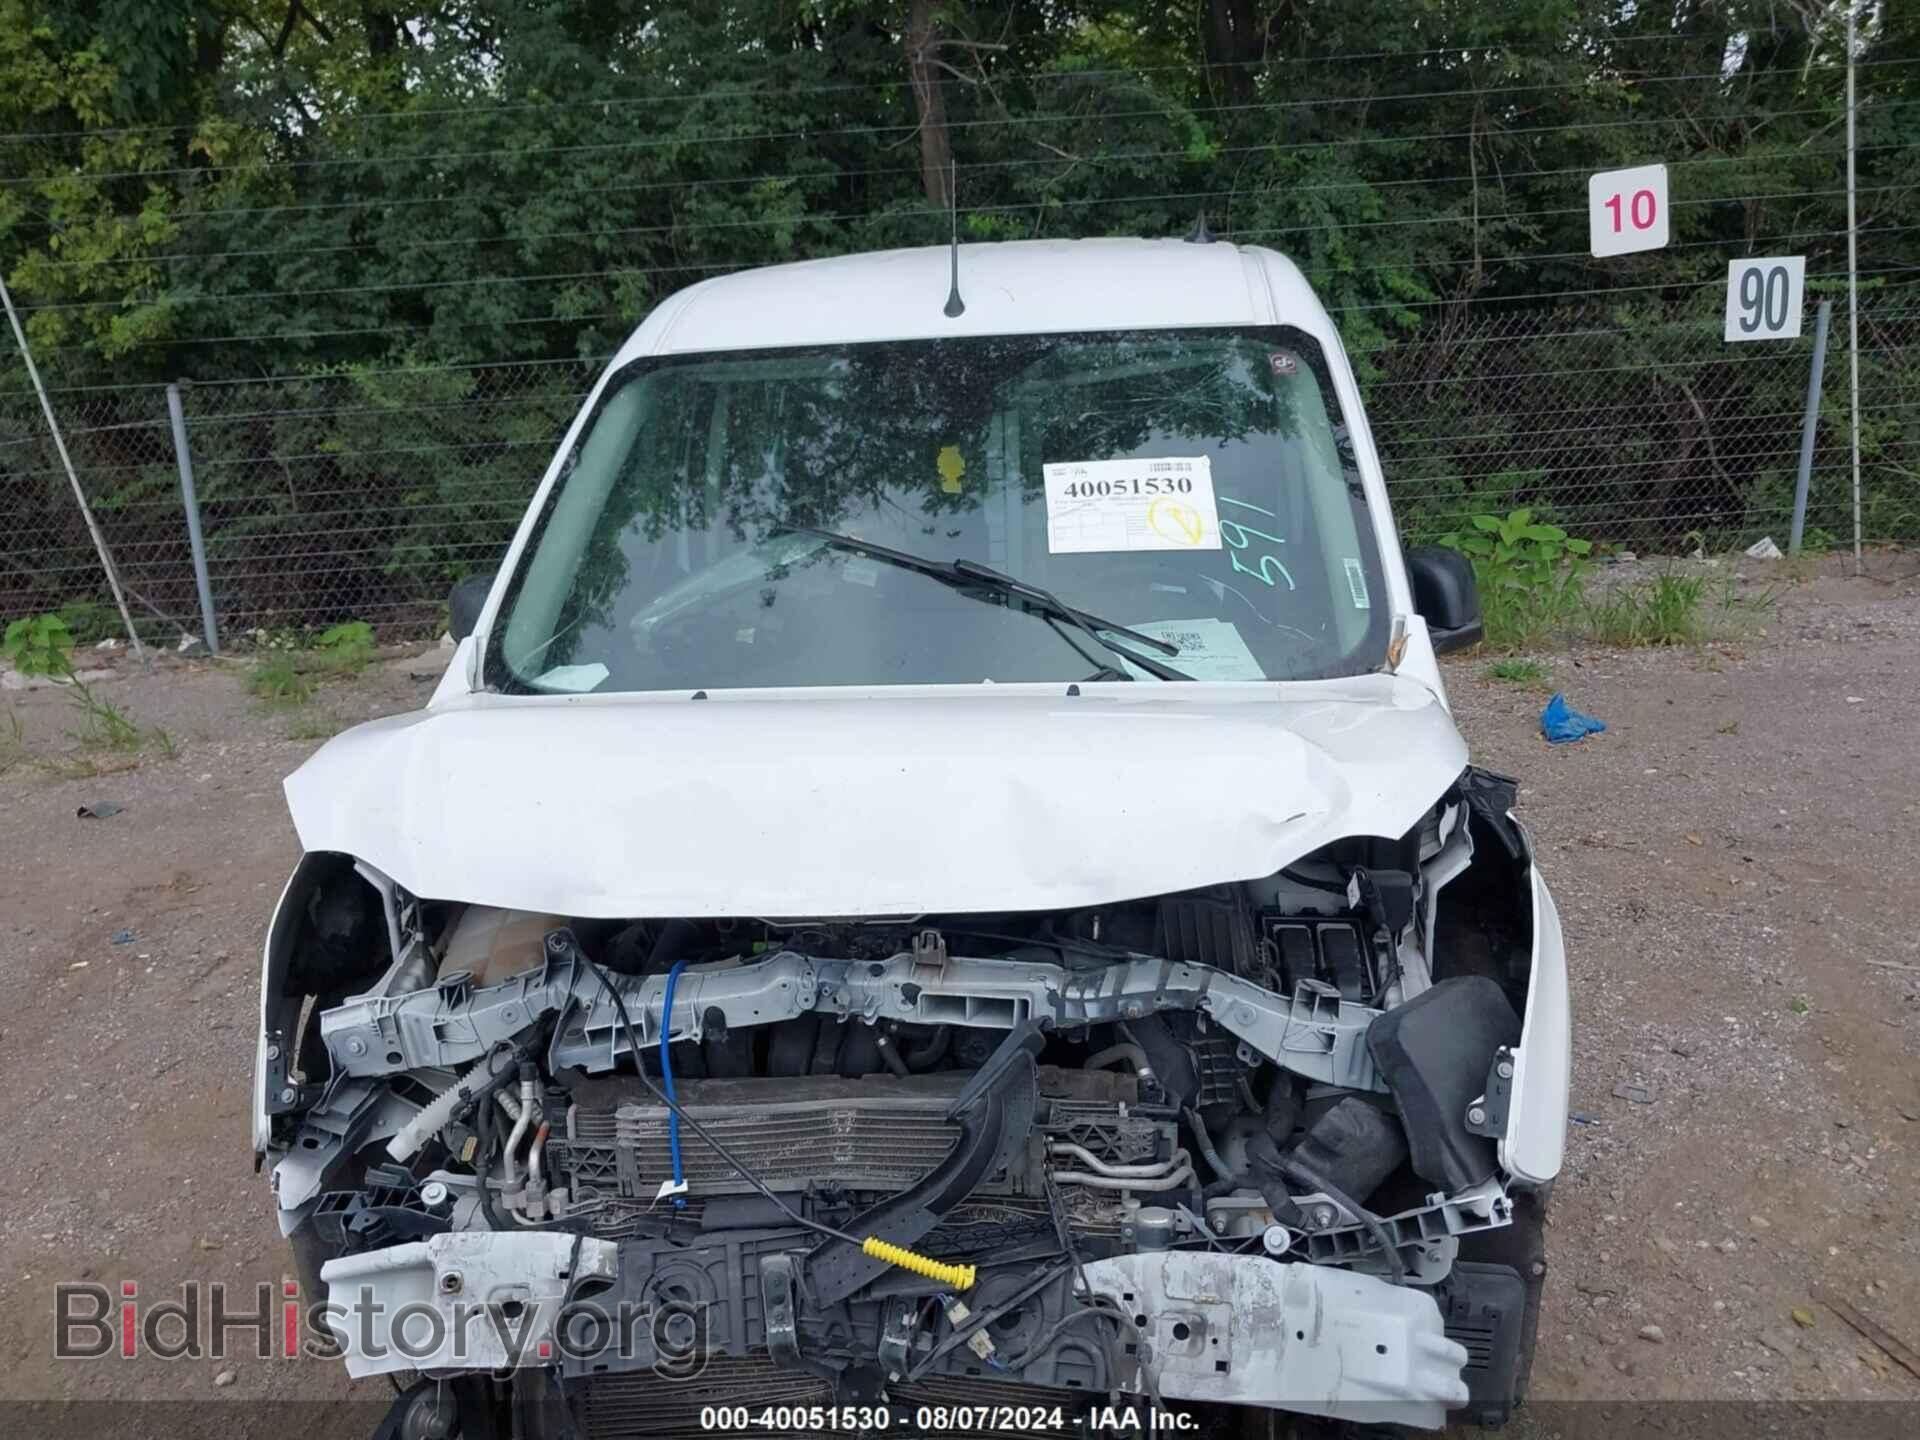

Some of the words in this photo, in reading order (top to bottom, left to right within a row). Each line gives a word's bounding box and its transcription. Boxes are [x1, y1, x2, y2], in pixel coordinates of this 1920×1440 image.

[1604, 189, 1657, 233] 10
[1739, 265, 1790, 333] 90
[1063, 477, 1193, 499] 40051530
